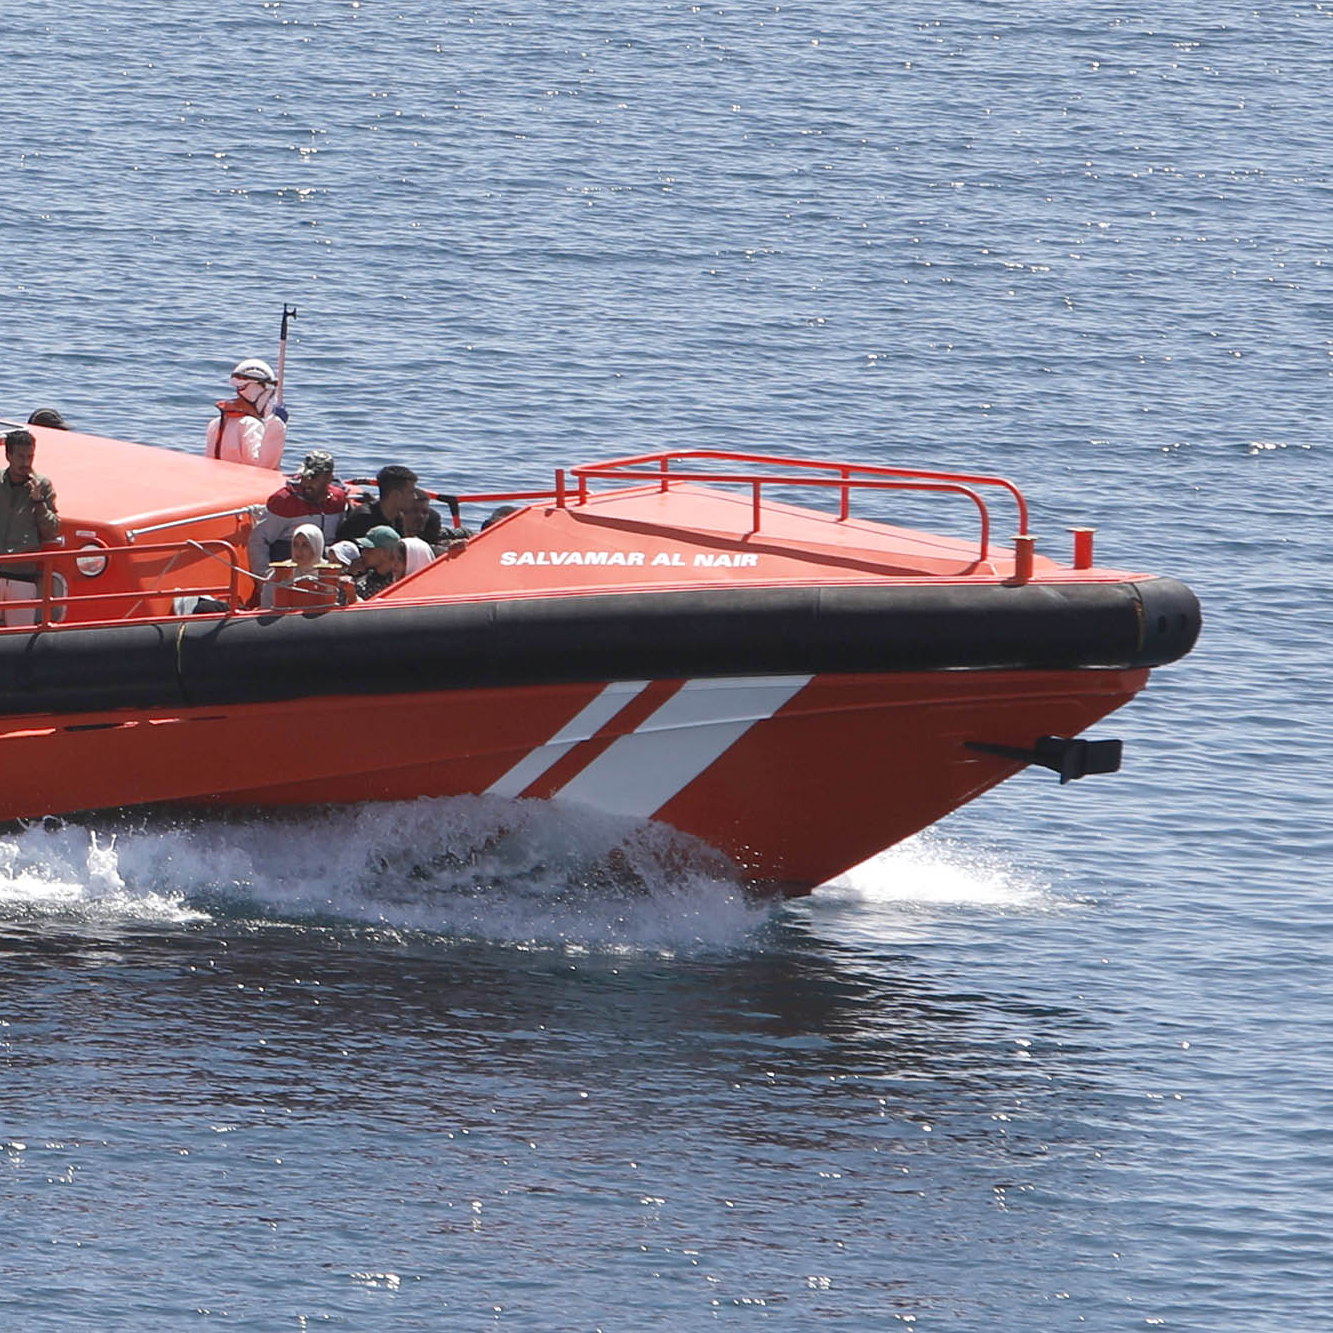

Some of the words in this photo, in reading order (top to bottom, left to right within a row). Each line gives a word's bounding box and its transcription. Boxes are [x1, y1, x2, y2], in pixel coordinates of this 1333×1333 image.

[500, 551, 646, 566] SALVAMAR
[651, 552, 686, 567] AL
[693, 553, 759, 568] NAIR
